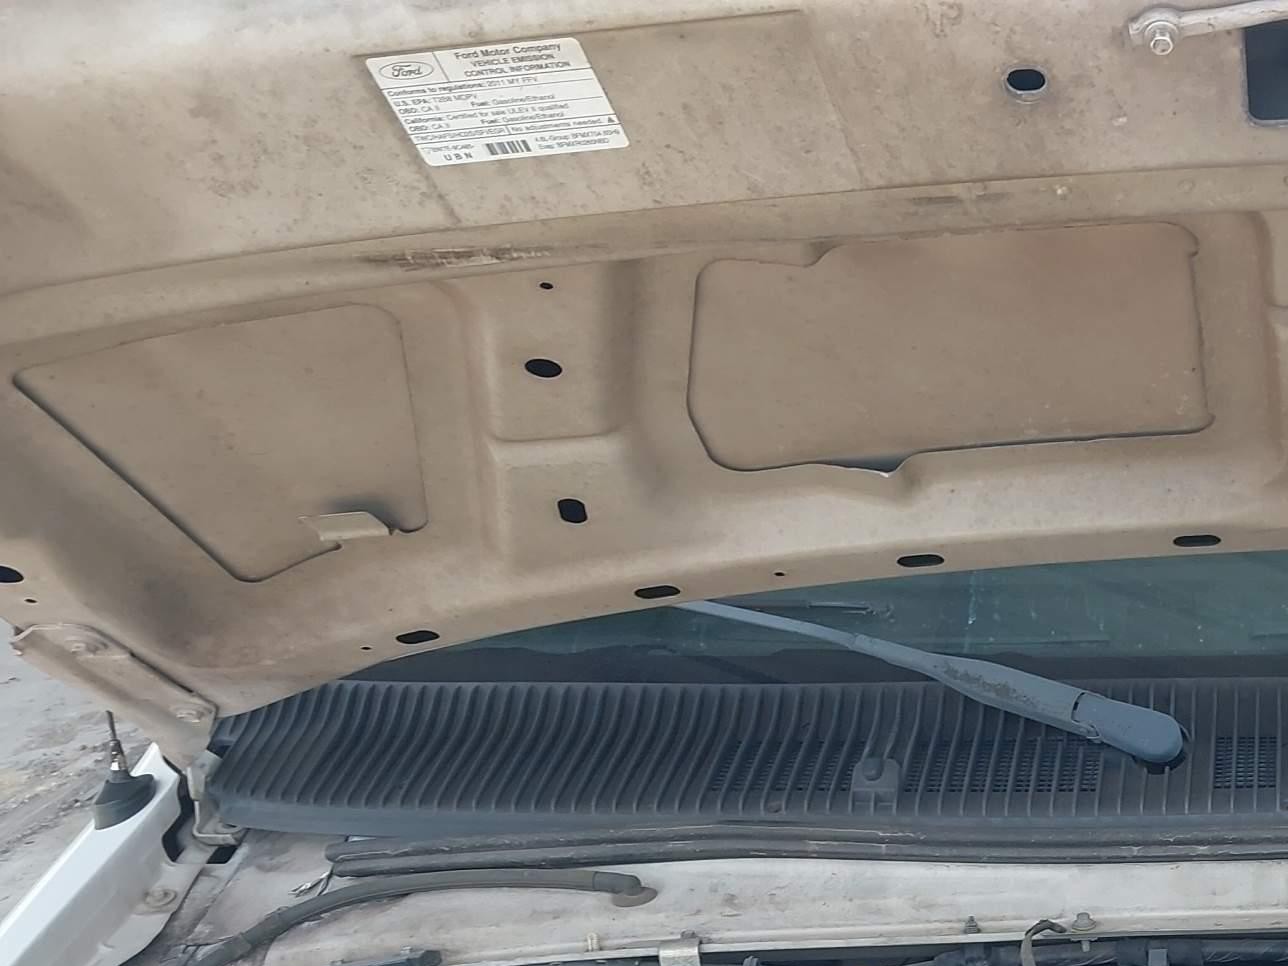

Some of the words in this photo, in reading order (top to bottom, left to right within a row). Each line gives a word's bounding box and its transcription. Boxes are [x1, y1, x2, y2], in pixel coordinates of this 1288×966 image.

[453, 51, 479, 59] Ford
[479, 47, 512, 56] Motor
[511, 42, 563, 55] Company
[470, 57, 510, 66] VEHICLE
[510, 53, 555, 62] EMISSION
[391, 64, 423, 77] Ford
[463, 67, 508, 77] CONTROL
[508, 61, 571, 72] INFORMATION
